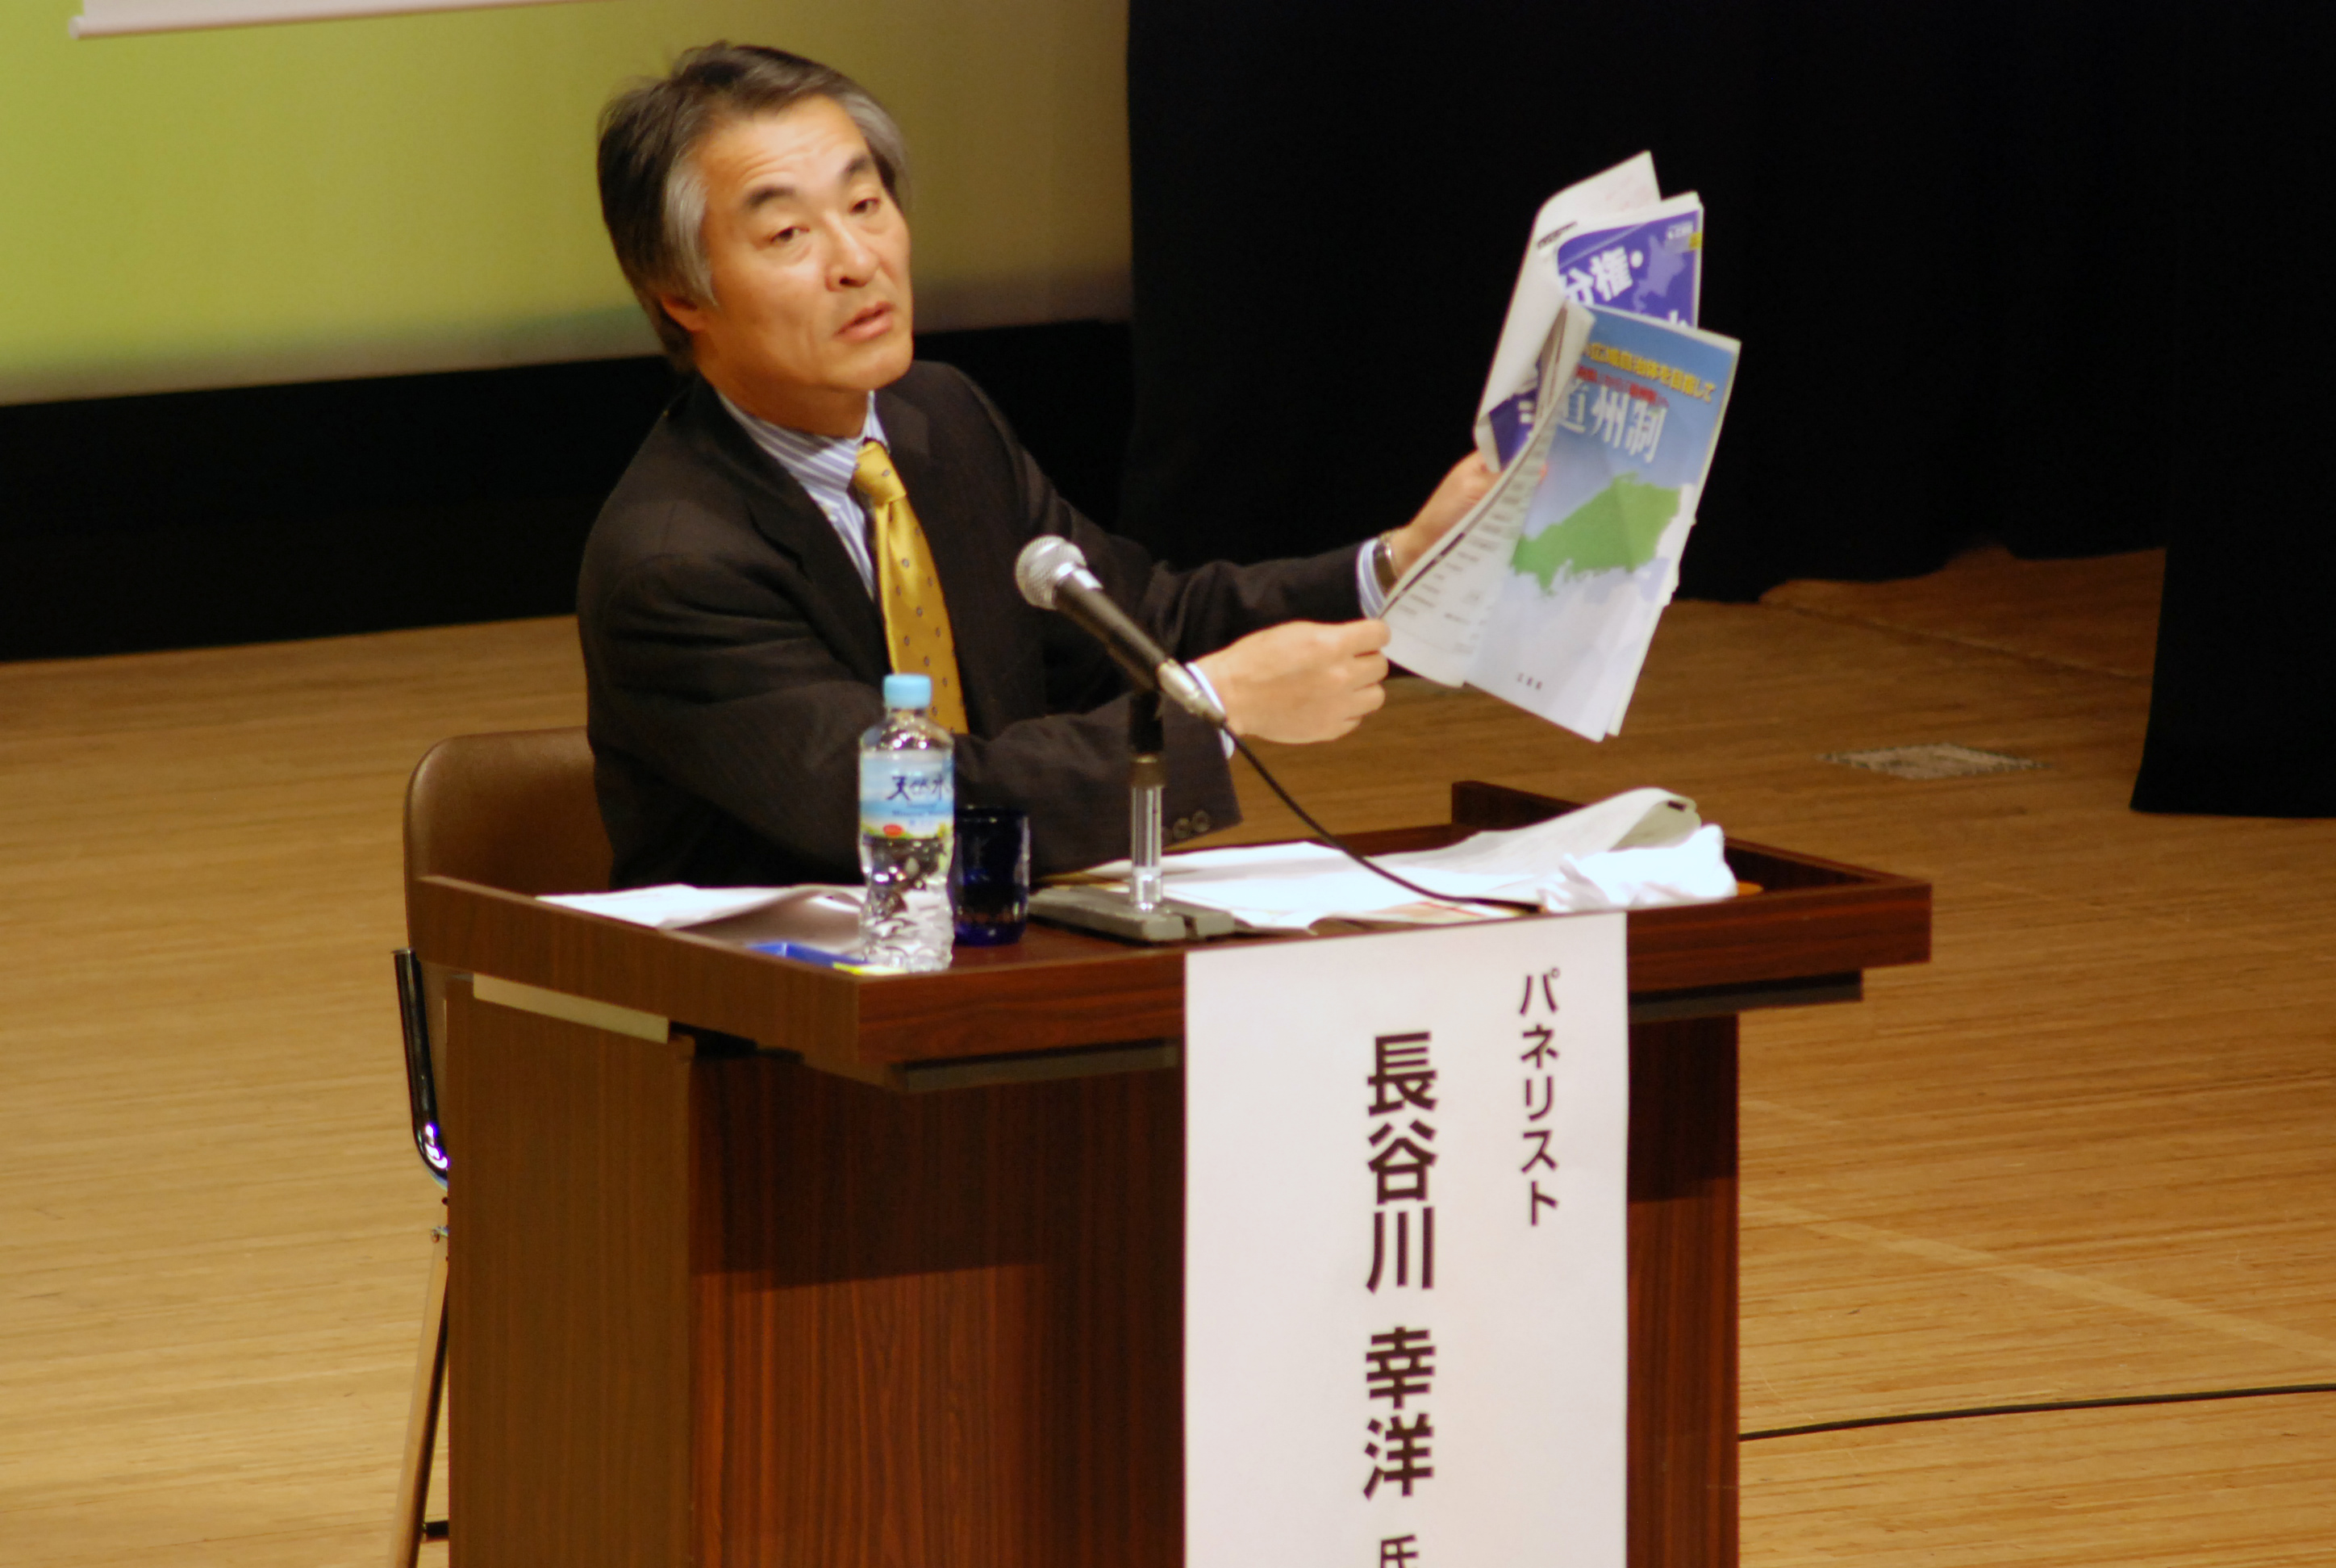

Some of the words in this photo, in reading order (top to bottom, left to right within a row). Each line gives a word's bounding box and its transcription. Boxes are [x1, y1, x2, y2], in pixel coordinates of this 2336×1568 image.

[1366, 1032, 1437, 1294] 長谷川
[1520, 968, 1558, 1226] パネリスト
[1363, 1326, 1436, 1500] 幸洋
